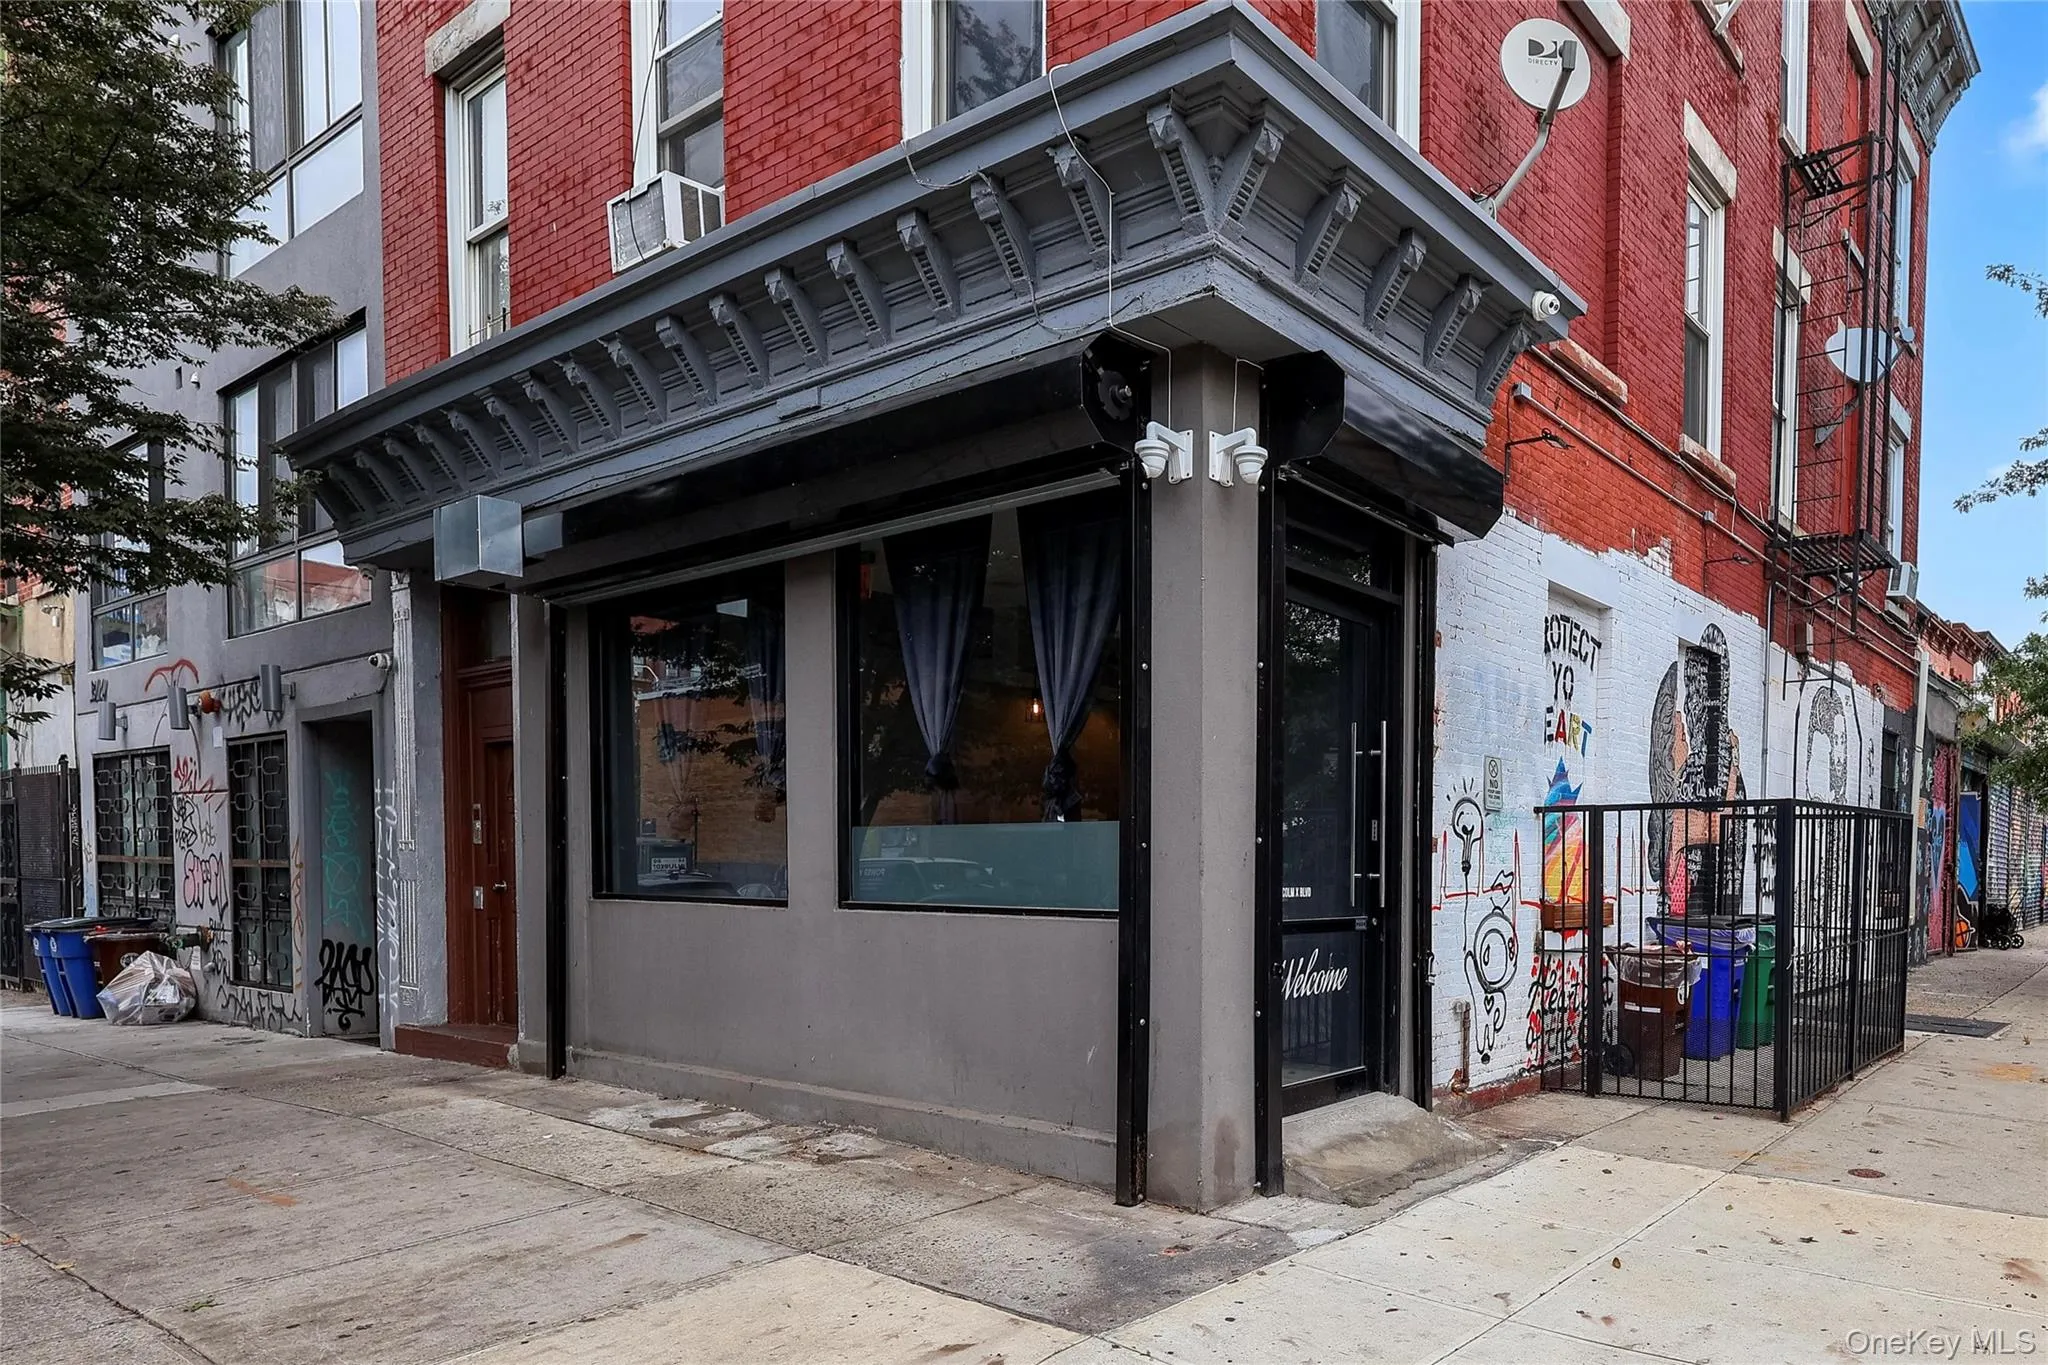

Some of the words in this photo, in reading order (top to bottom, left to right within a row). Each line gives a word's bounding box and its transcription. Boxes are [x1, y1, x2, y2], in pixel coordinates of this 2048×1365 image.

[1528, 58, 1558, 66] DIRECTV
[1552, 661, 1574, 700] YO
[1281, 948, 1348, 1001] Welcome
